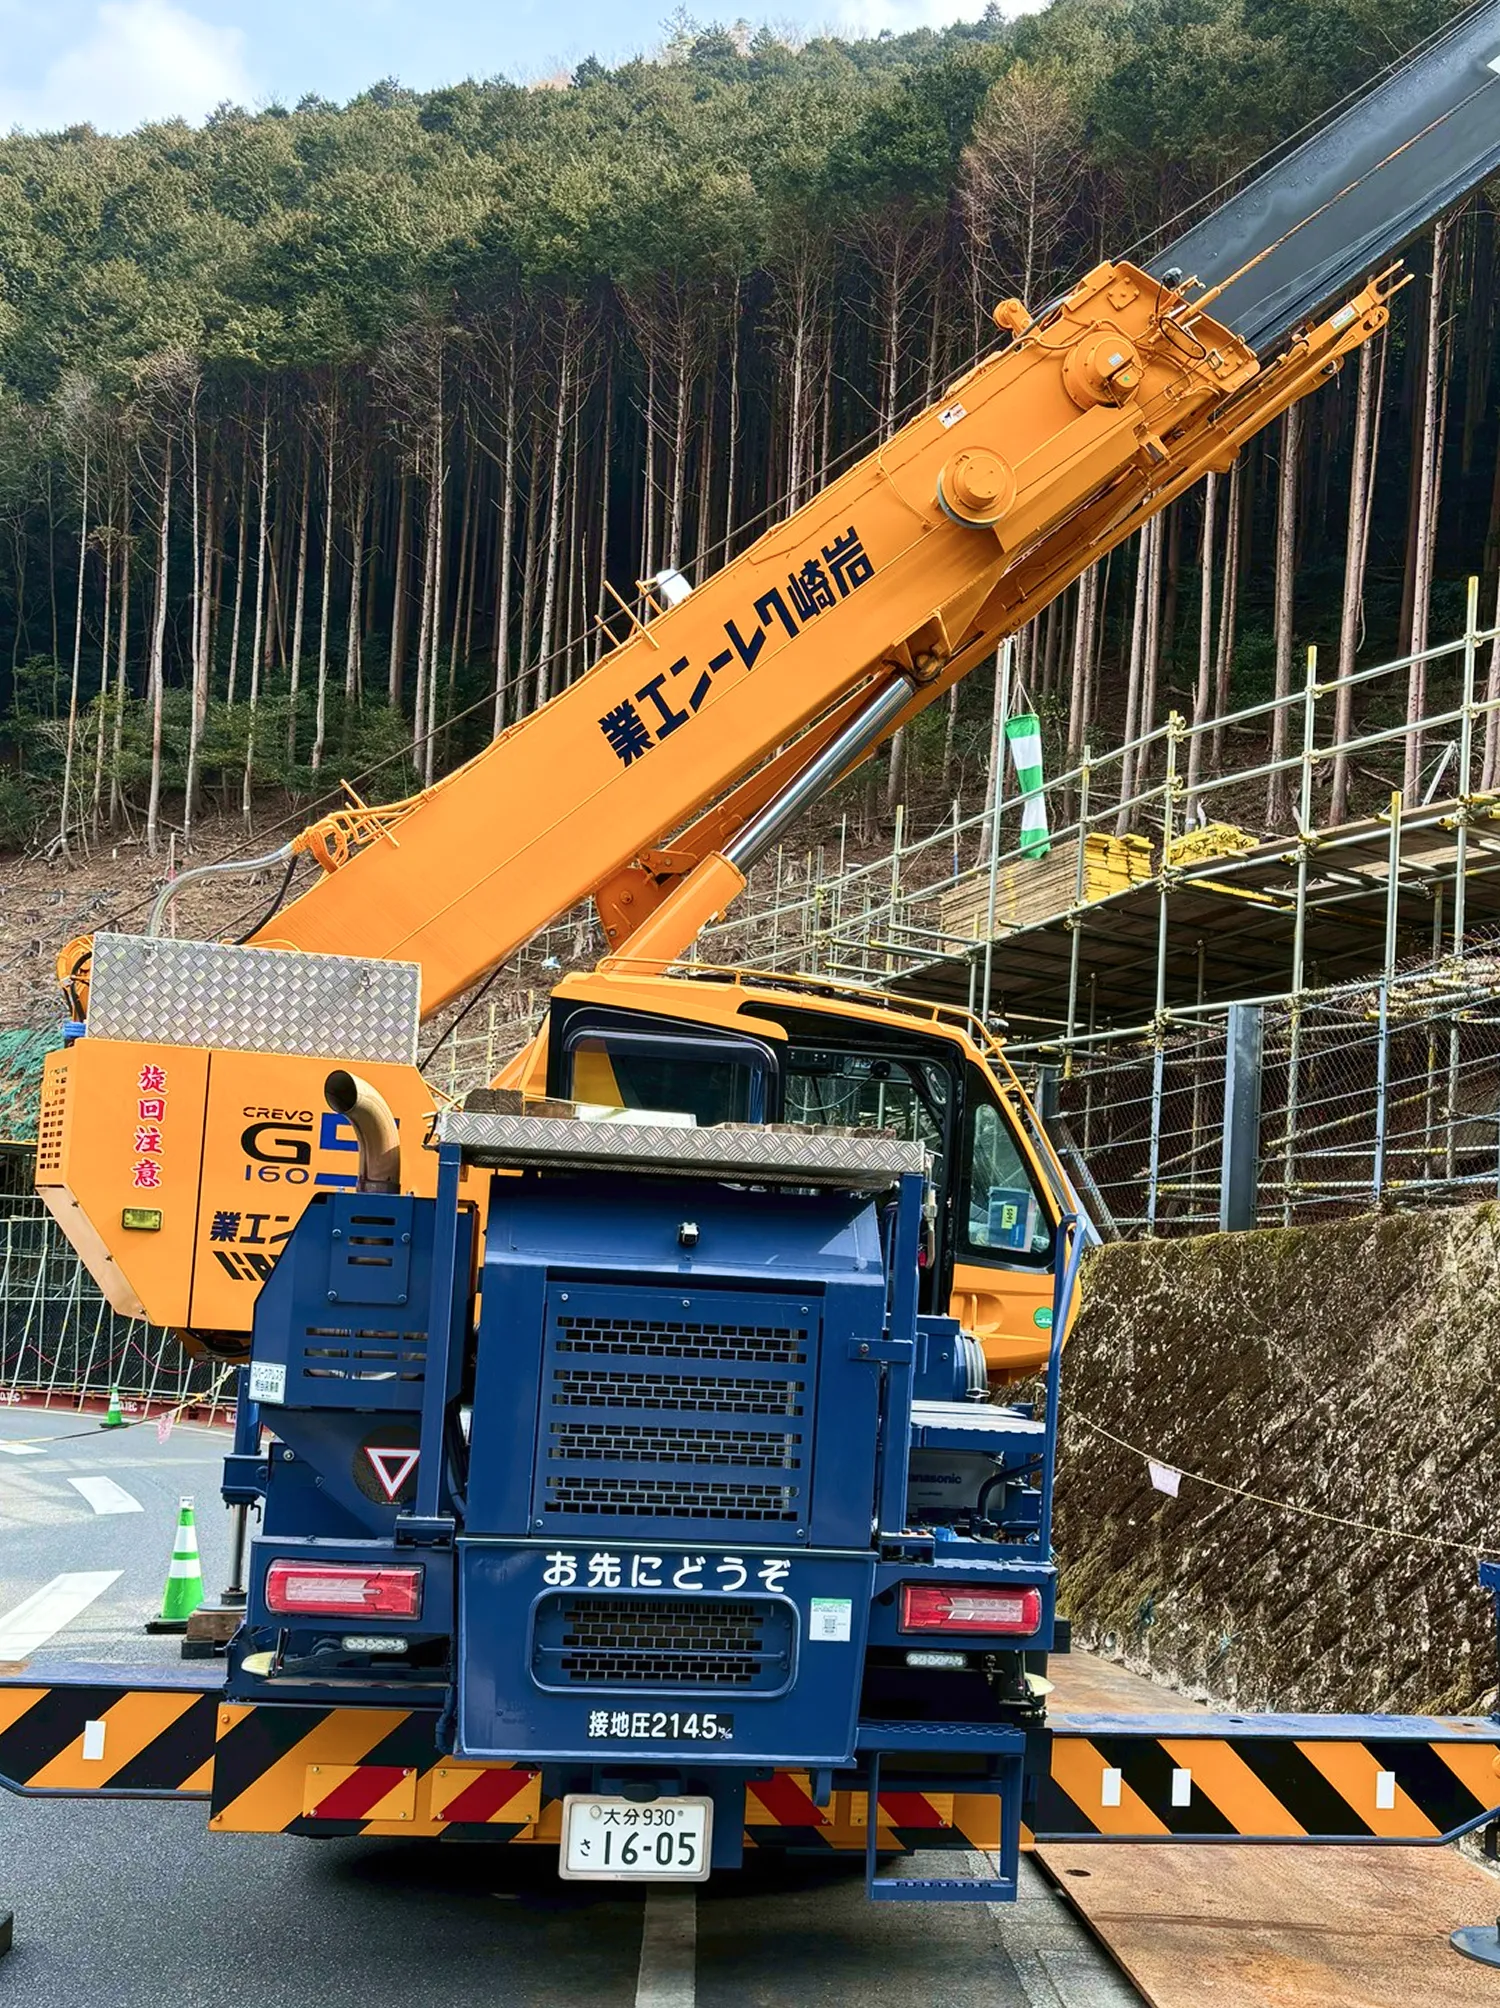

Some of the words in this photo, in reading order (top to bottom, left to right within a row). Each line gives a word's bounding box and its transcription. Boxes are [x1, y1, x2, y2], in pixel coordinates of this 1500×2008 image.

[133, 1064, 168, 1187] 旋回注意
[243, 1106, 314, 1123] CREVO
[245, 1164, 310, 1185] 160
[908, 1472, 962, 1485] anasonic
[542, 1551, 792, 1592] お先にどうぞ
[580, 1838, 592, 1857] さ
[604, 1830, 697, 1866] 16-05
